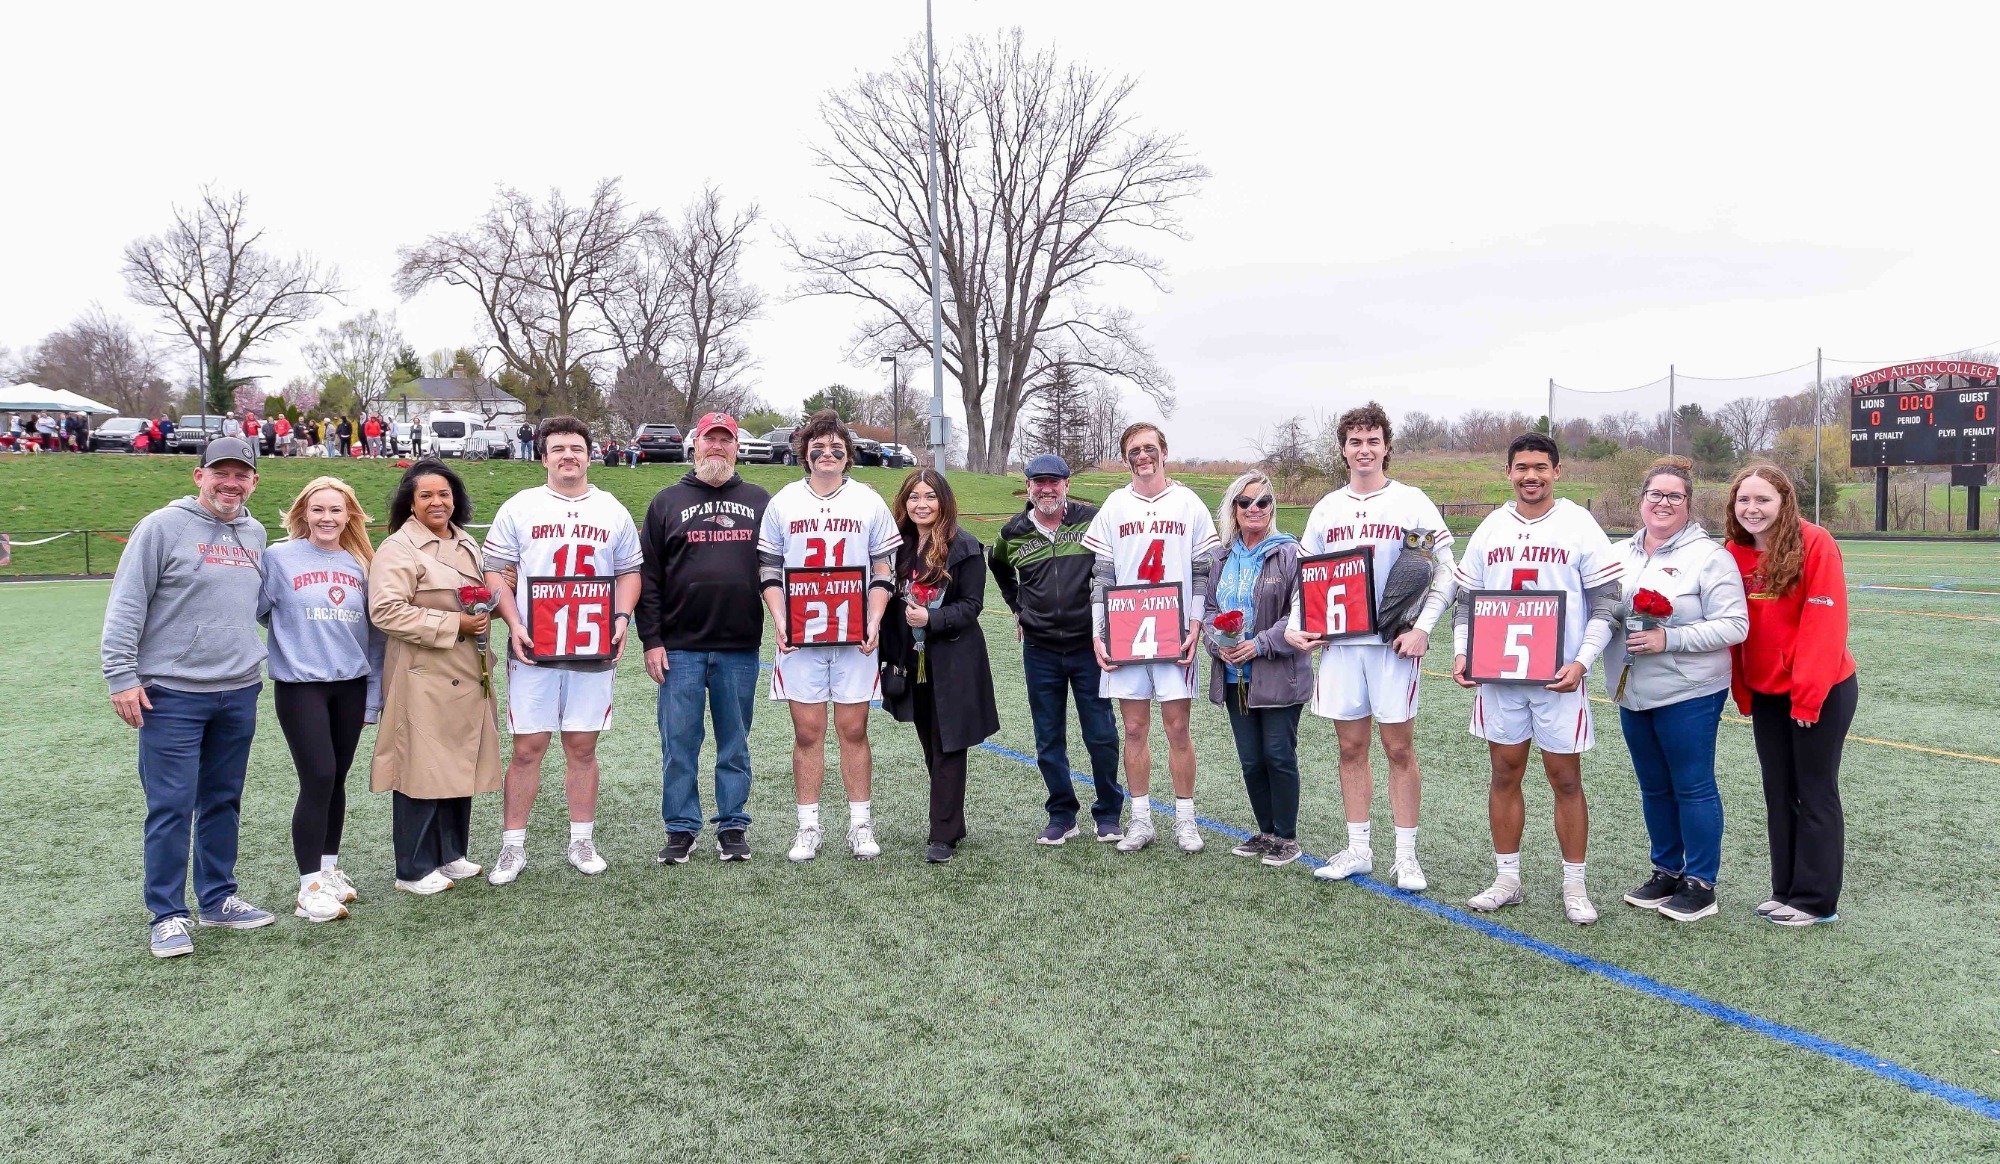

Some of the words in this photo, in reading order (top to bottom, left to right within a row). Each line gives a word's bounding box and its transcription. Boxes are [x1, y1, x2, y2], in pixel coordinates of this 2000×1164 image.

[1855, 369, 1887, 388] BRYN
[1890, 363, 1934, 378] ATHYN
[1937, 361, 1994, 377] COLLEGE
[1860, 399, 1885, 409] LIONS
[1959, 392, 1989, 403] GUEST
[1871, 411, 1880, 426] 0
[1897, 416, 1920, 425] PERIOD
[1975, 404, 1985, 420] 0
[1851, 433, 1867, 441] PLYR
[1874, 431, 1903, 440] PENALTY
[1938, 429, 1956, 437] PLYR
[1963, 427, 1995, 436] PENALTY
[715, 500, 755, 520] ATHYN
[531, 523, 566, 540] BRYN
[571, 523, 610, 543] ATHYN
[687, 530, 706, 543] ICE
[709, 529, 753, 542] HOCKEY
[790, 518, 819, 535] BRYN
[823, 518, 862, 534] ATHYN
[1119, 521, 1144, 539] BRYN
[1149, 520, 1187, 536] ATHYN
[1326, 525, 1354, 543] BRYN
[1359, 523, 1401, 541] ATHYN
[552, 543, 596, 577] 15
[803, 537, 846, 567] 21
[1138, 539, 1166, 584] 4
[1487, 546, 1515, 567] BRYN
[1520, 546, 1570, 565] ATHYN
[293, 570, 329, 591] BRYN
[532, 584, 567, 599] BRYN
[305, 607, 363, 623] LACROSSE
[1326, 584, 1347, 635] 6
[1475, 600, 1511, 617] BRYN
[553, 603, 602, 656] 15
[803, 599, 849, 643] 21
[1131, 616, 1158, 660] 4
[1500, 623, 1534, 680] 5
